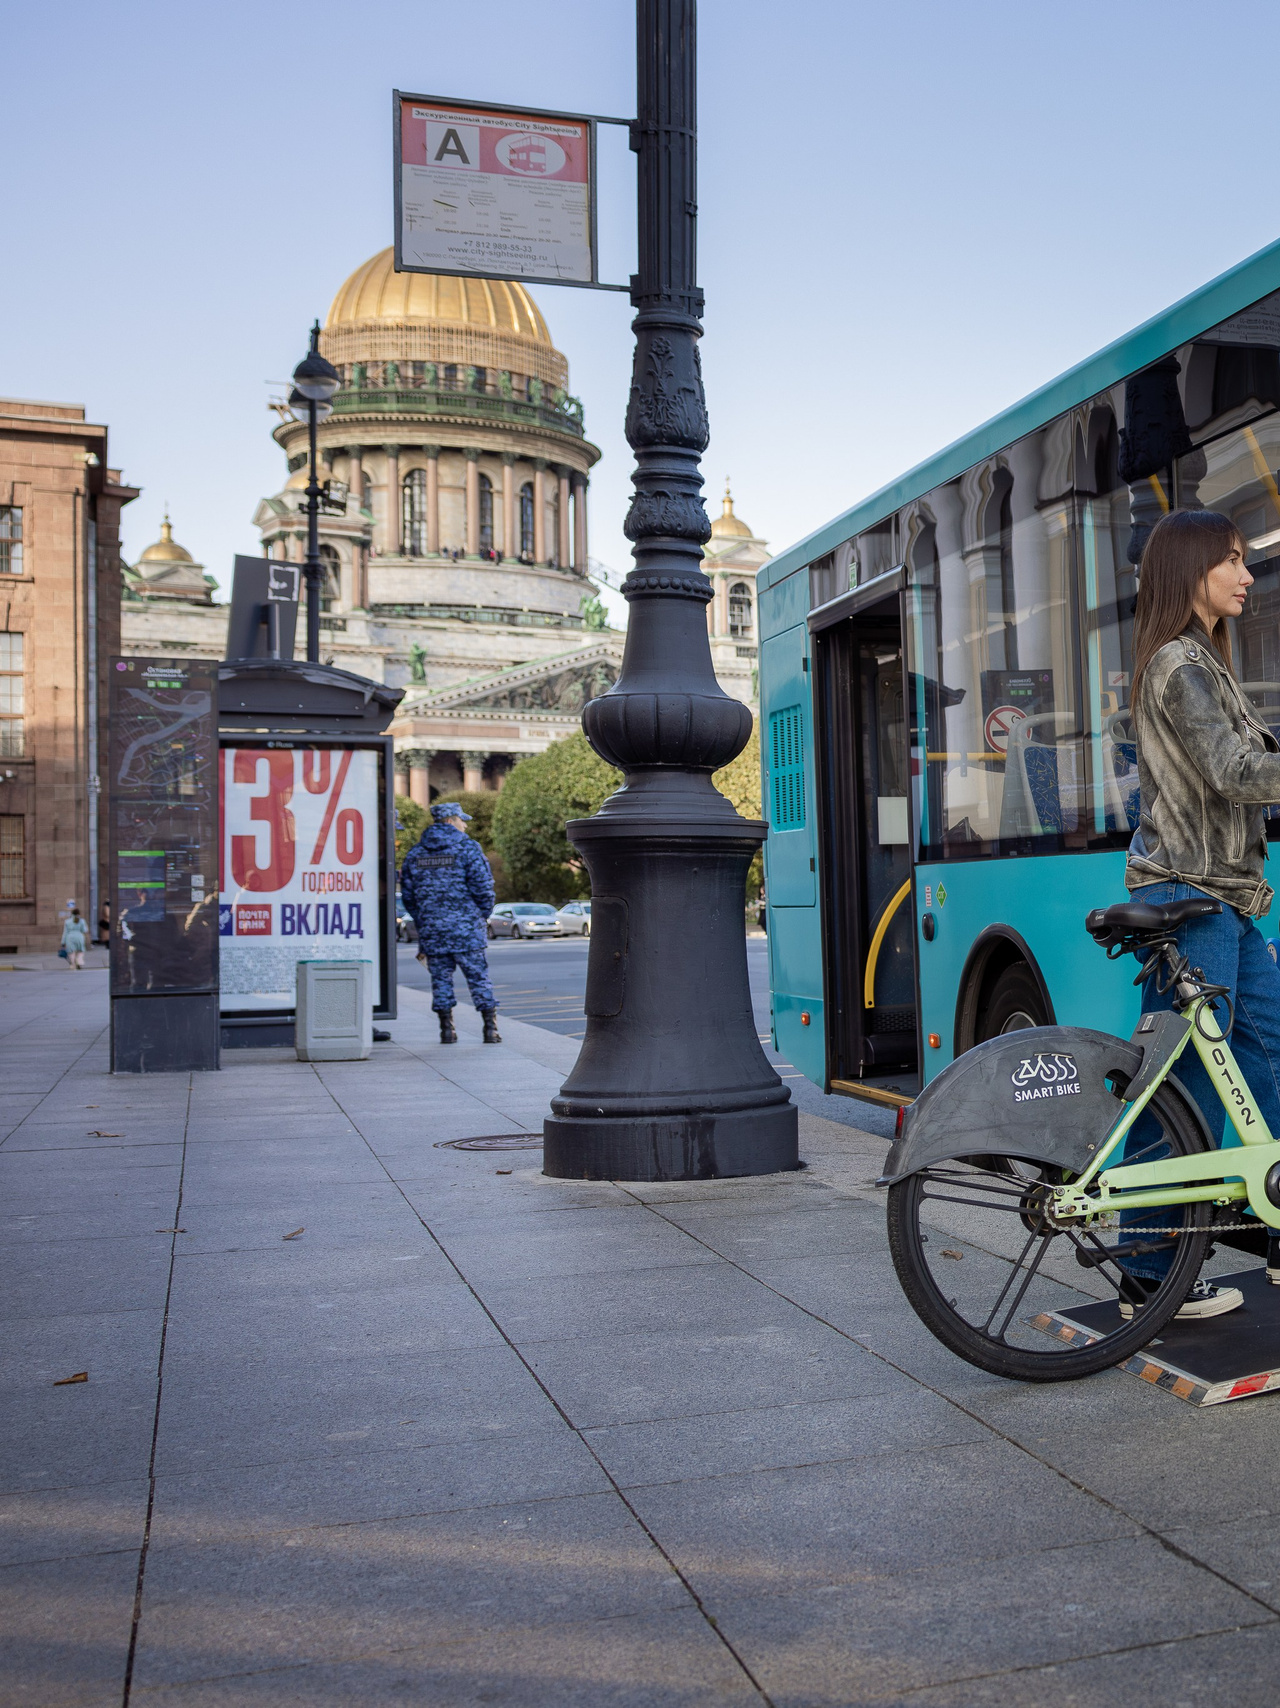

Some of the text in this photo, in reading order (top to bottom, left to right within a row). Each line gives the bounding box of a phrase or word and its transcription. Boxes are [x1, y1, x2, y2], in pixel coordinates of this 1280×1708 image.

[414, 109, 578, 135] Экскурсионный автобус City Sightseeing
[447, 246, 548, 261] www.city-sightseeing.ru
[475, 241, 490, 249] 812
[492, 242, 532, 253] 989-55-33
[219, 749, 364, 893] 3%
[302, 871, 364, 894] ГОДОВЫХ
[238, 910, 270, 919] ПОЧТА
[238, 920, 266, 929] БАНК
[281, 903, 364, 939] ВКЛАД
[1014, 1082, 1081, 1102] SMART BIKE
[1211, 1047, 1256, 1126] 0132
